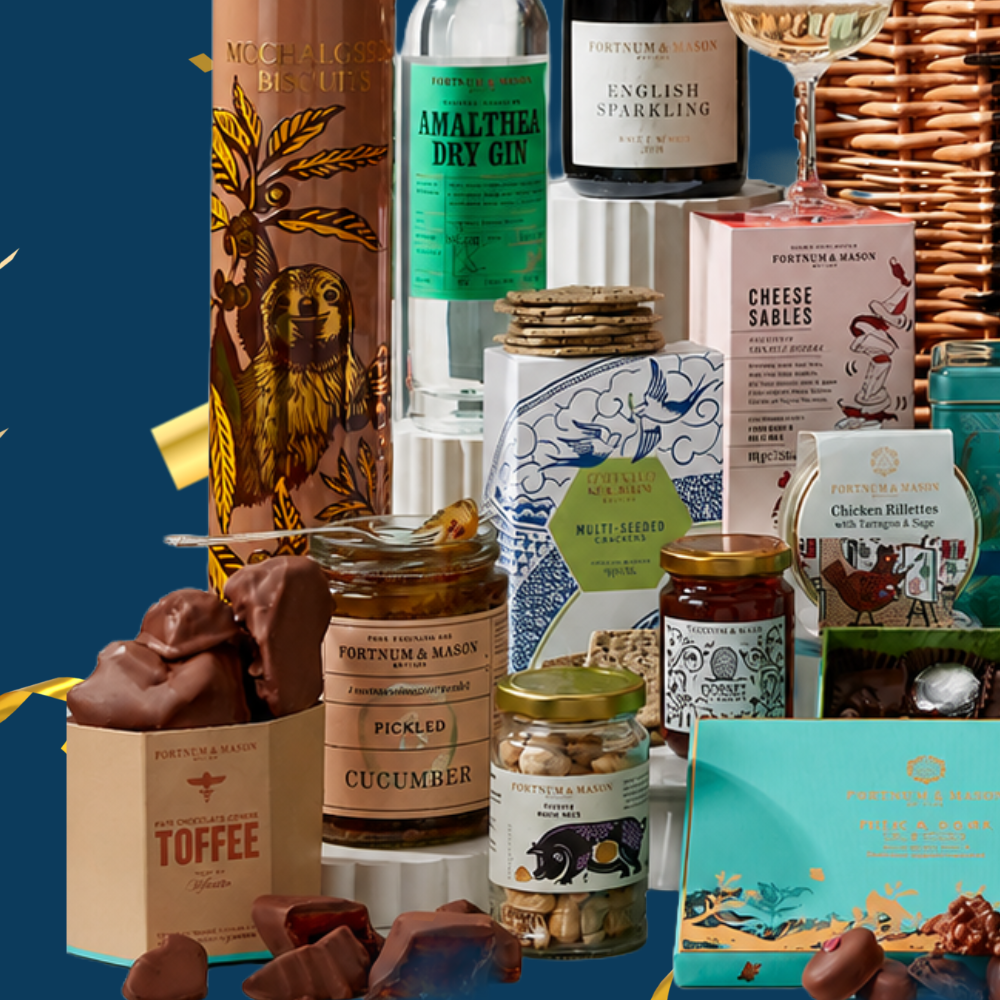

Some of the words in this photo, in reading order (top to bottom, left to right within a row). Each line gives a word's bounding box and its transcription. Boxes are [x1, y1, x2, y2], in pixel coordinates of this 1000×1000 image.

[588, 41, 655, 54] FORTNUM
[657, 42, 669, 54] &
[672, 39, 718, 53] MASON
[608, 83, 699, 99] ENGLISH
[596, 101, 711, 118] SPARKLING
[418, 108, 541, 137] AMALTHEA
[432, 140, 481, 168] DRY
[488, 138, 528, 167] GIN
[772, 253, 827, 264] FORTNUM
[828, 253, 837, 262] &
[839, 250, 876, 261] MASON
[748, 286, 812, 306] CHEESE
[748, 307, 812, 327] SABLES
[900, 482, 940, 494] MASON
[830, 504, 883, 518] Chicken
[885, 503, 939, 516] Rillettes
[575, 520, 666, 537] MULTI-SEEDED
[339, 645, 414, 661] FORTNUM
[417, 647, 428, 660] &
[431, 640, 479, 659] MASON
[374, 719, 446, 735] PICKLED
[220, 742, 257, 754] MASON
[345, 764, 472, 790] CUCUMBER
[576, 782, 613, 795] MASON
[154, 821, 260, 867] TOFFEE
